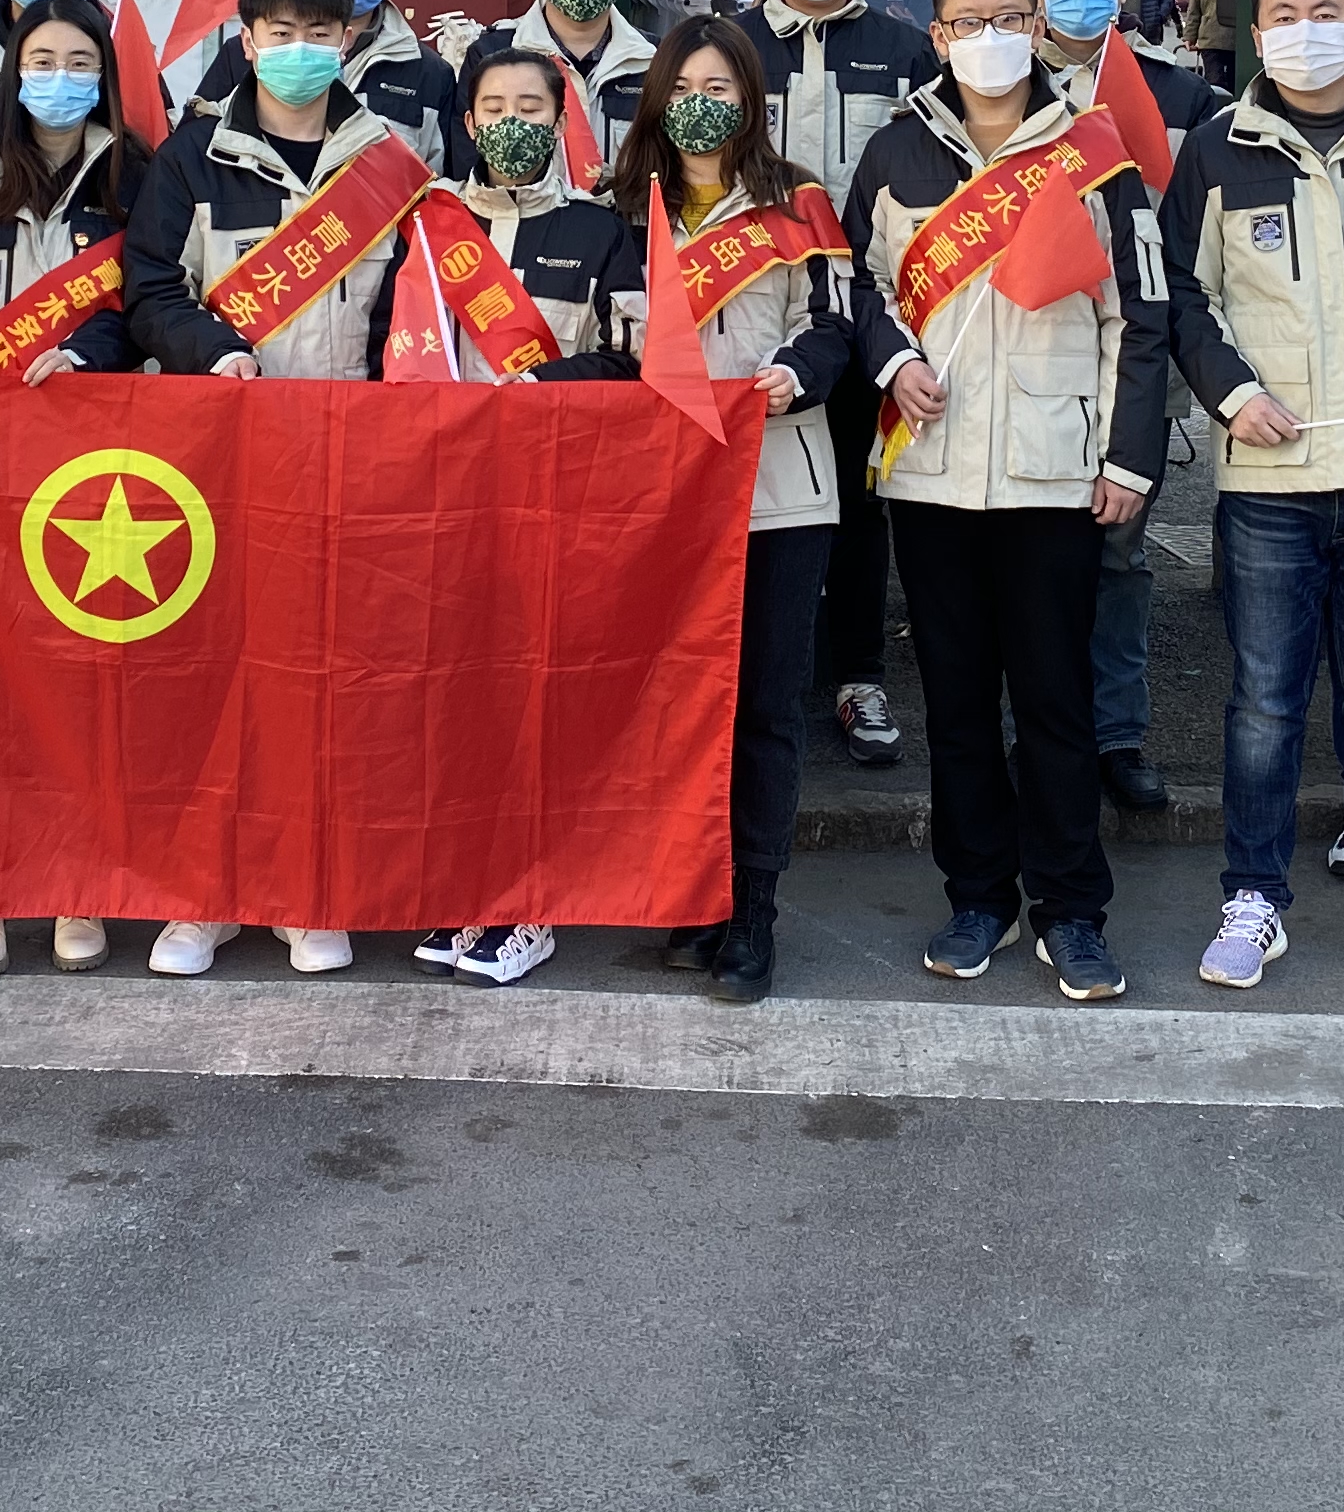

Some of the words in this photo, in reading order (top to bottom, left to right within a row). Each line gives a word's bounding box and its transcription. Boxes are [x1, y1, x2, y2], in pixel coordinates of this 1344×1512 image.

[219, 210, 352, 328] 青岛水务
[680, 221, 777, 298] 青岛水
